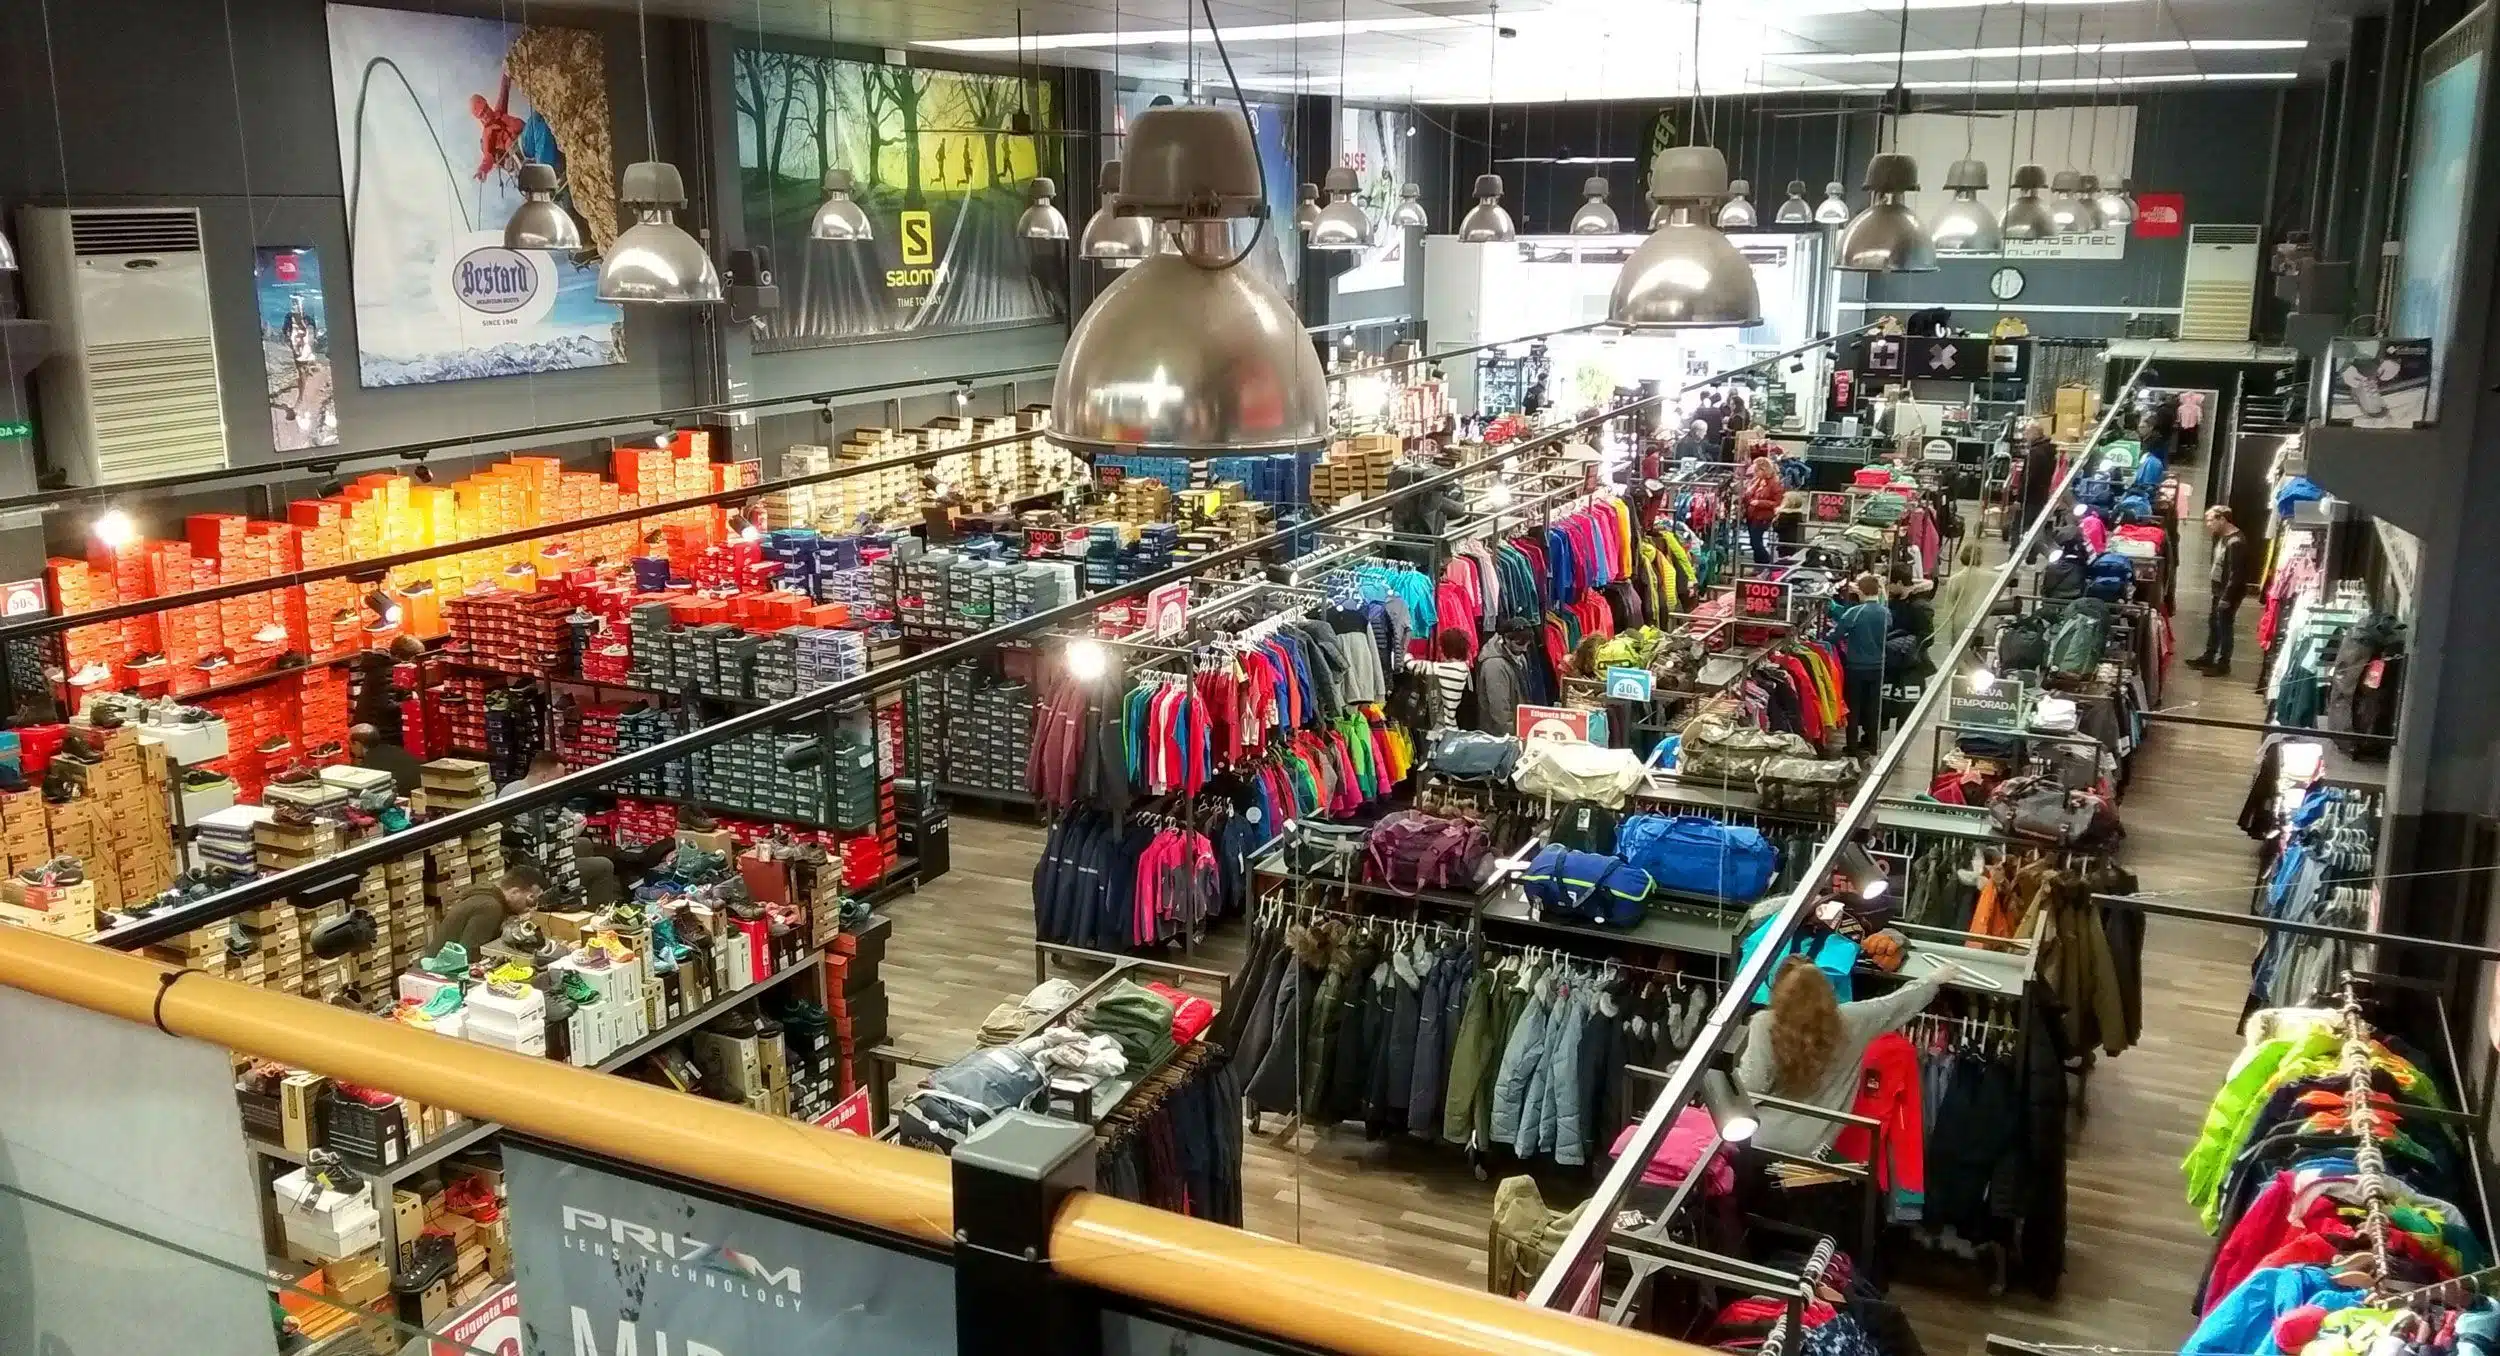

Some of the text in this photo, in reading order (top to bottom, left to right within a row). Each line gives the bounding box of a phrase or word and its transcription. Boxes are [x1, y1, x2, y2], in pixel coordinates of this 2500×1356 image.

[462, 259, 529, 297] Bestard
[897, 297, 914, 308] TIME
[482, 318, 518, 327] SINCE 1940
[1818, 495, 1845, 505] TODO
[1030, 531, 1055, 542] TODO
[1745, 584, 1780, 597] TODO
[1952, 697, 2017, 711] TEMPORADA
[563, 1234, 802, 1312] LENS TECHNOLOGY
[454, 1303, 501, 1343] Etiqueta
